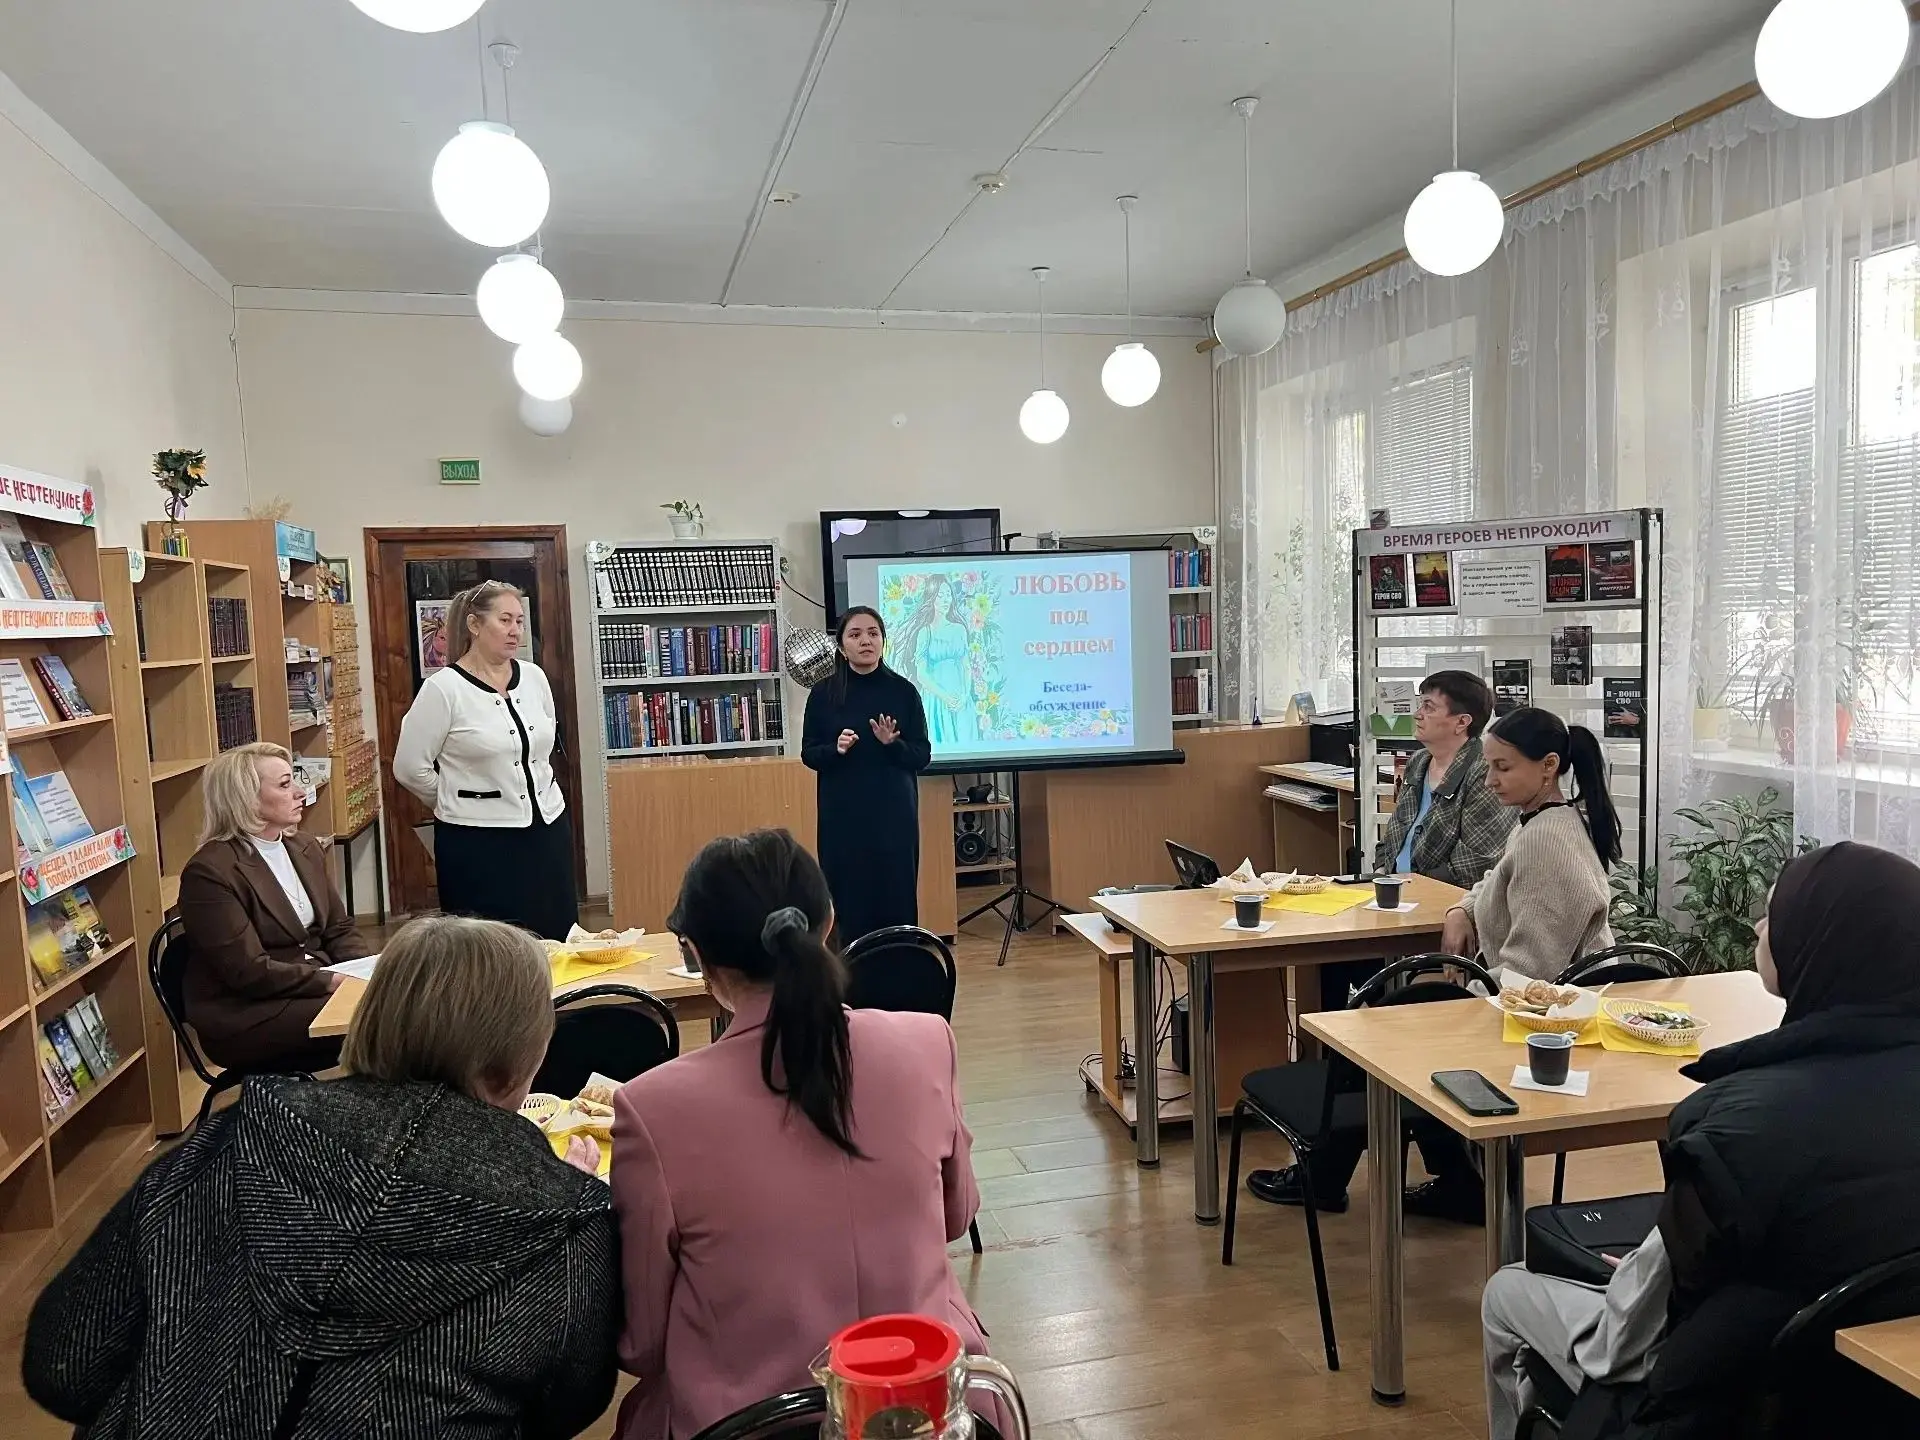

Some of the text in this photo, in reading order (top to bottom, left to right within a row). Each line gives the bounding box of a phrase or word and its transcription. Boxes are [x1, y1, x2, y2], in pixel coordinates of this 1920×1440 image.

[442, 463, 477, 479] ВЫХОД
[1197, 527, 1216, 538] 16+
[1383, 519, 1612, 547] ВРЕМЯ ГЕРОЕВ НЕ ПРОХОДИТ
[1010, 572, 1127, 595] ЛЮБОВЬ
[1049, 610, 1089, 625] под
[1024, 639, 1114, 660] сердцем
[1043, 681, 1092, 693] Беседа-
[1029, 700, 1107, 711] обсуждение
